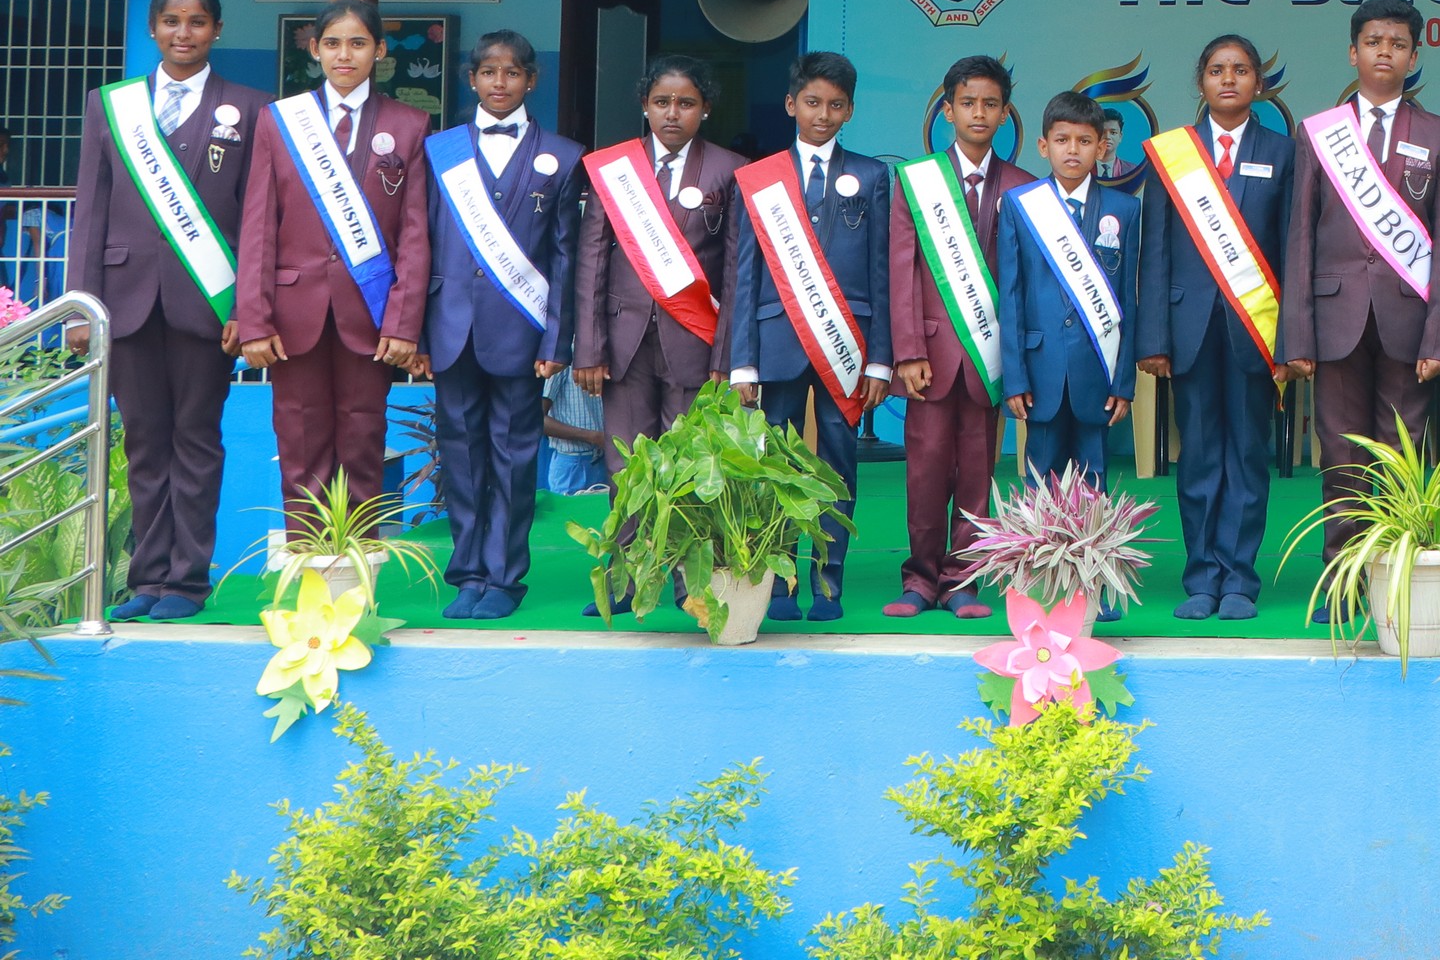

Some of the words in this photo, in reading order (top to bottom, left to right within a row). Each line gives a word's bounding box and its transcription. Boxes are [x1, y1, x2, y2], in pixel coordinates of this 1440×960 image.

[945, 13, 969, 22] AND
[132, 124, 162, 175] SPORTS
[155, 176, 200, 242] MINISTER
[295, 109, 338, 179] EDUCATION
[330, 181, 368, 249] MINISTER
[1196, 195, 1221, 232] HEAD
[1217, 233, 1240, 267] GIRL
[1325, 125, 1382, 208] HEAD
[1373, 208, 1432, 270] BOY
[642, 218, 673, 267] MINISTER
[770, 203, 795, 245] WATER
[788, 244, 829, 319] RESOURCES
[822, 319, 856, 376] MINISTER
[932, 201, 951, 234] ASST.
[945, 235, 970, 282] SPORTS
[963, 283, 993, 341] MINISTER
[1056, 235, 1083, 272] FOOD
[1079, 274, 1113, 338] MINISTER
